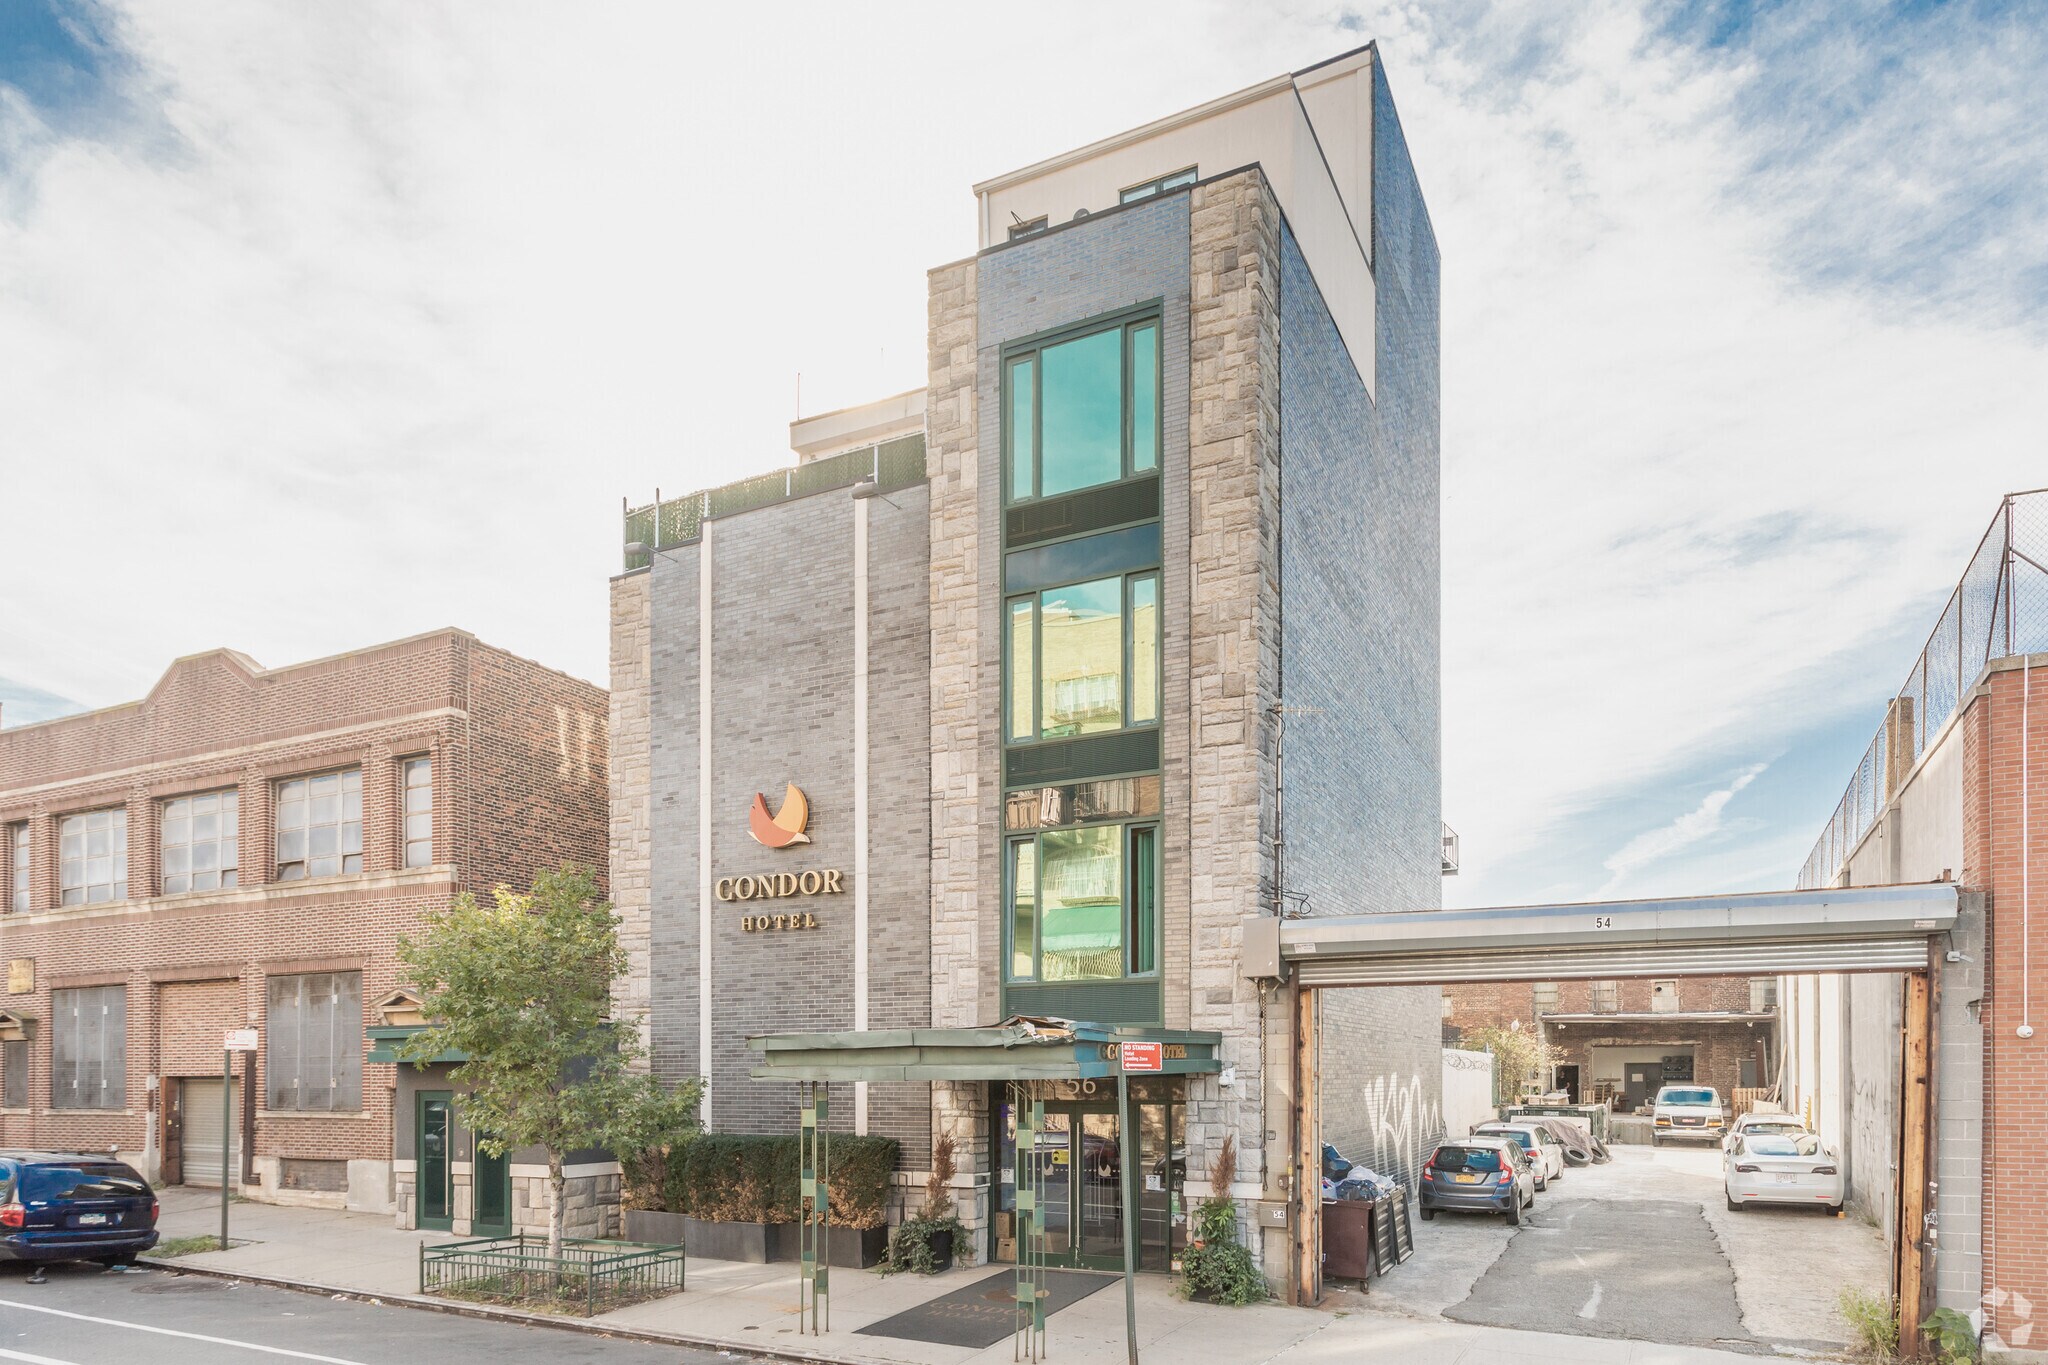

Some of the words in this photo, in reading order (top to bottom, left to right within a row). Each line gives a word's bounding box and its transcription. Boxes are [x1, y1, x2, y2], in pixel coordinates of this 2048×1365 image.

[715, 869, 842, 901] CONDOR
[741, 912, 816, 932] HOTEL
[1596, 917, 1611, 929] 54
[1162, 1044, 1187, 1059] OTEL
[1066, 1078, 1097, 1094] 56
[930, 1303, 1028, 1316] CONDO
